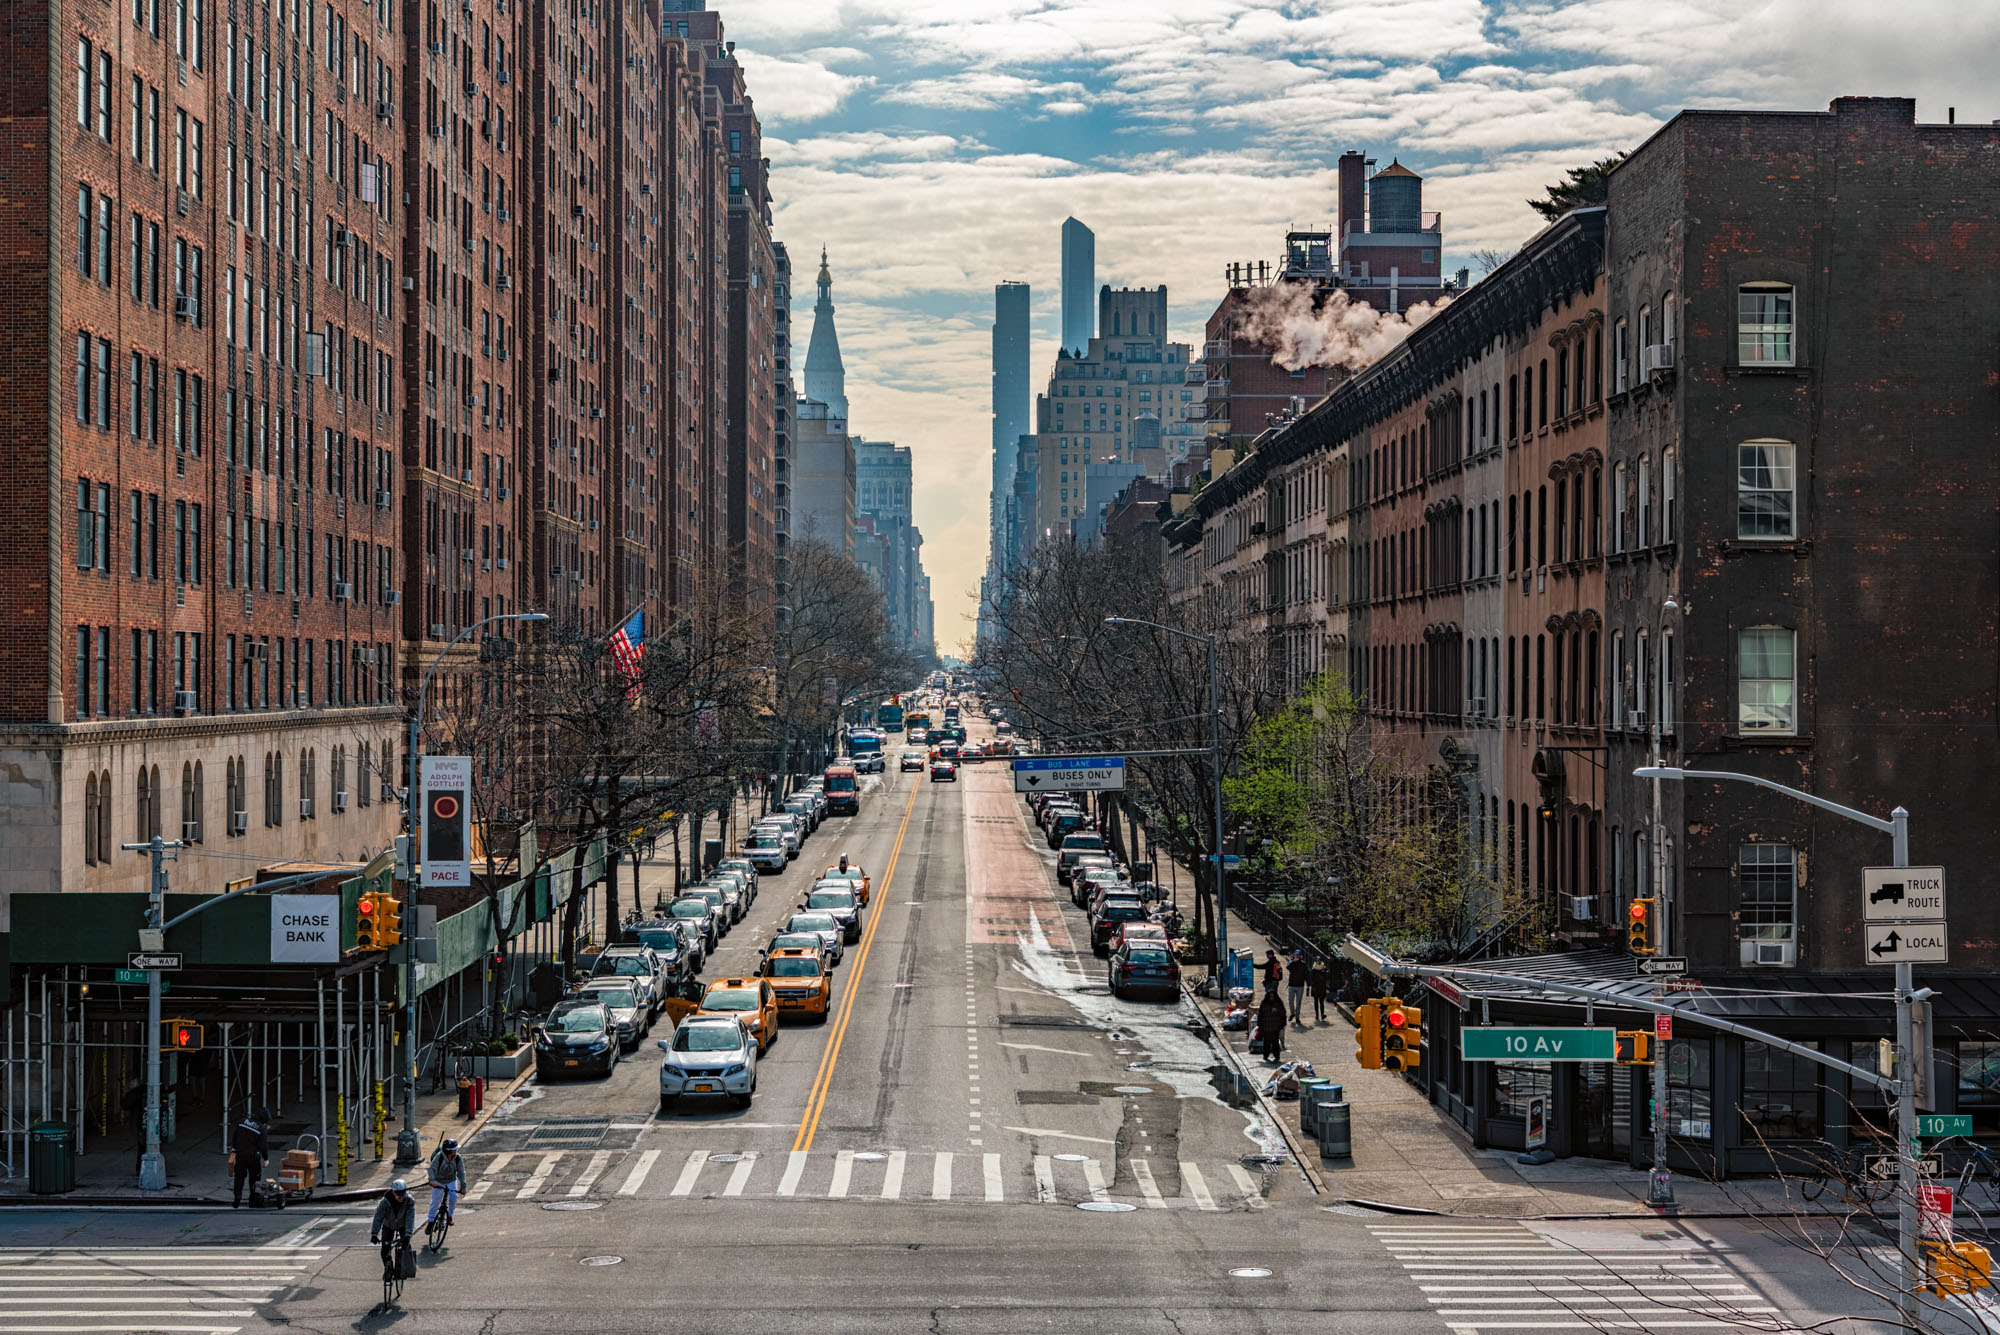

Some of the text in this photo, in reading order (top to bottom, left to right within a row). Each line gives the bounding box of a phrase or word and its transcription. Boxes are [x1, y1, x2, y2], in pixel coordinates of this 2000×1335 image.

[435, 762, 458, 771] NYC
[1070, 760, 1090, 768] LANE
[1052, 770, 1112, 780] BUSES ONLY
[431, 871, 460, 881] PACE
[1907, 880, 1940, 889] TRUCK
[1907, 898, 1940, 907] ROUTE
[282, 914, 329, 926] CHASE
[286, 931, 326, 942] BANK
[1906, 937, 1943, 948] LOCAL
[137, 958, 175, 966] ONE WAY
[120, 970, 130, 981] 10
[1673, 982, 1682, 991] 10
[1505, 1036, 1563, 1052] 10 Av
[1927, 1118, 1945, 1133] 10
[1877, 1163, 1899, 1173] ONE
